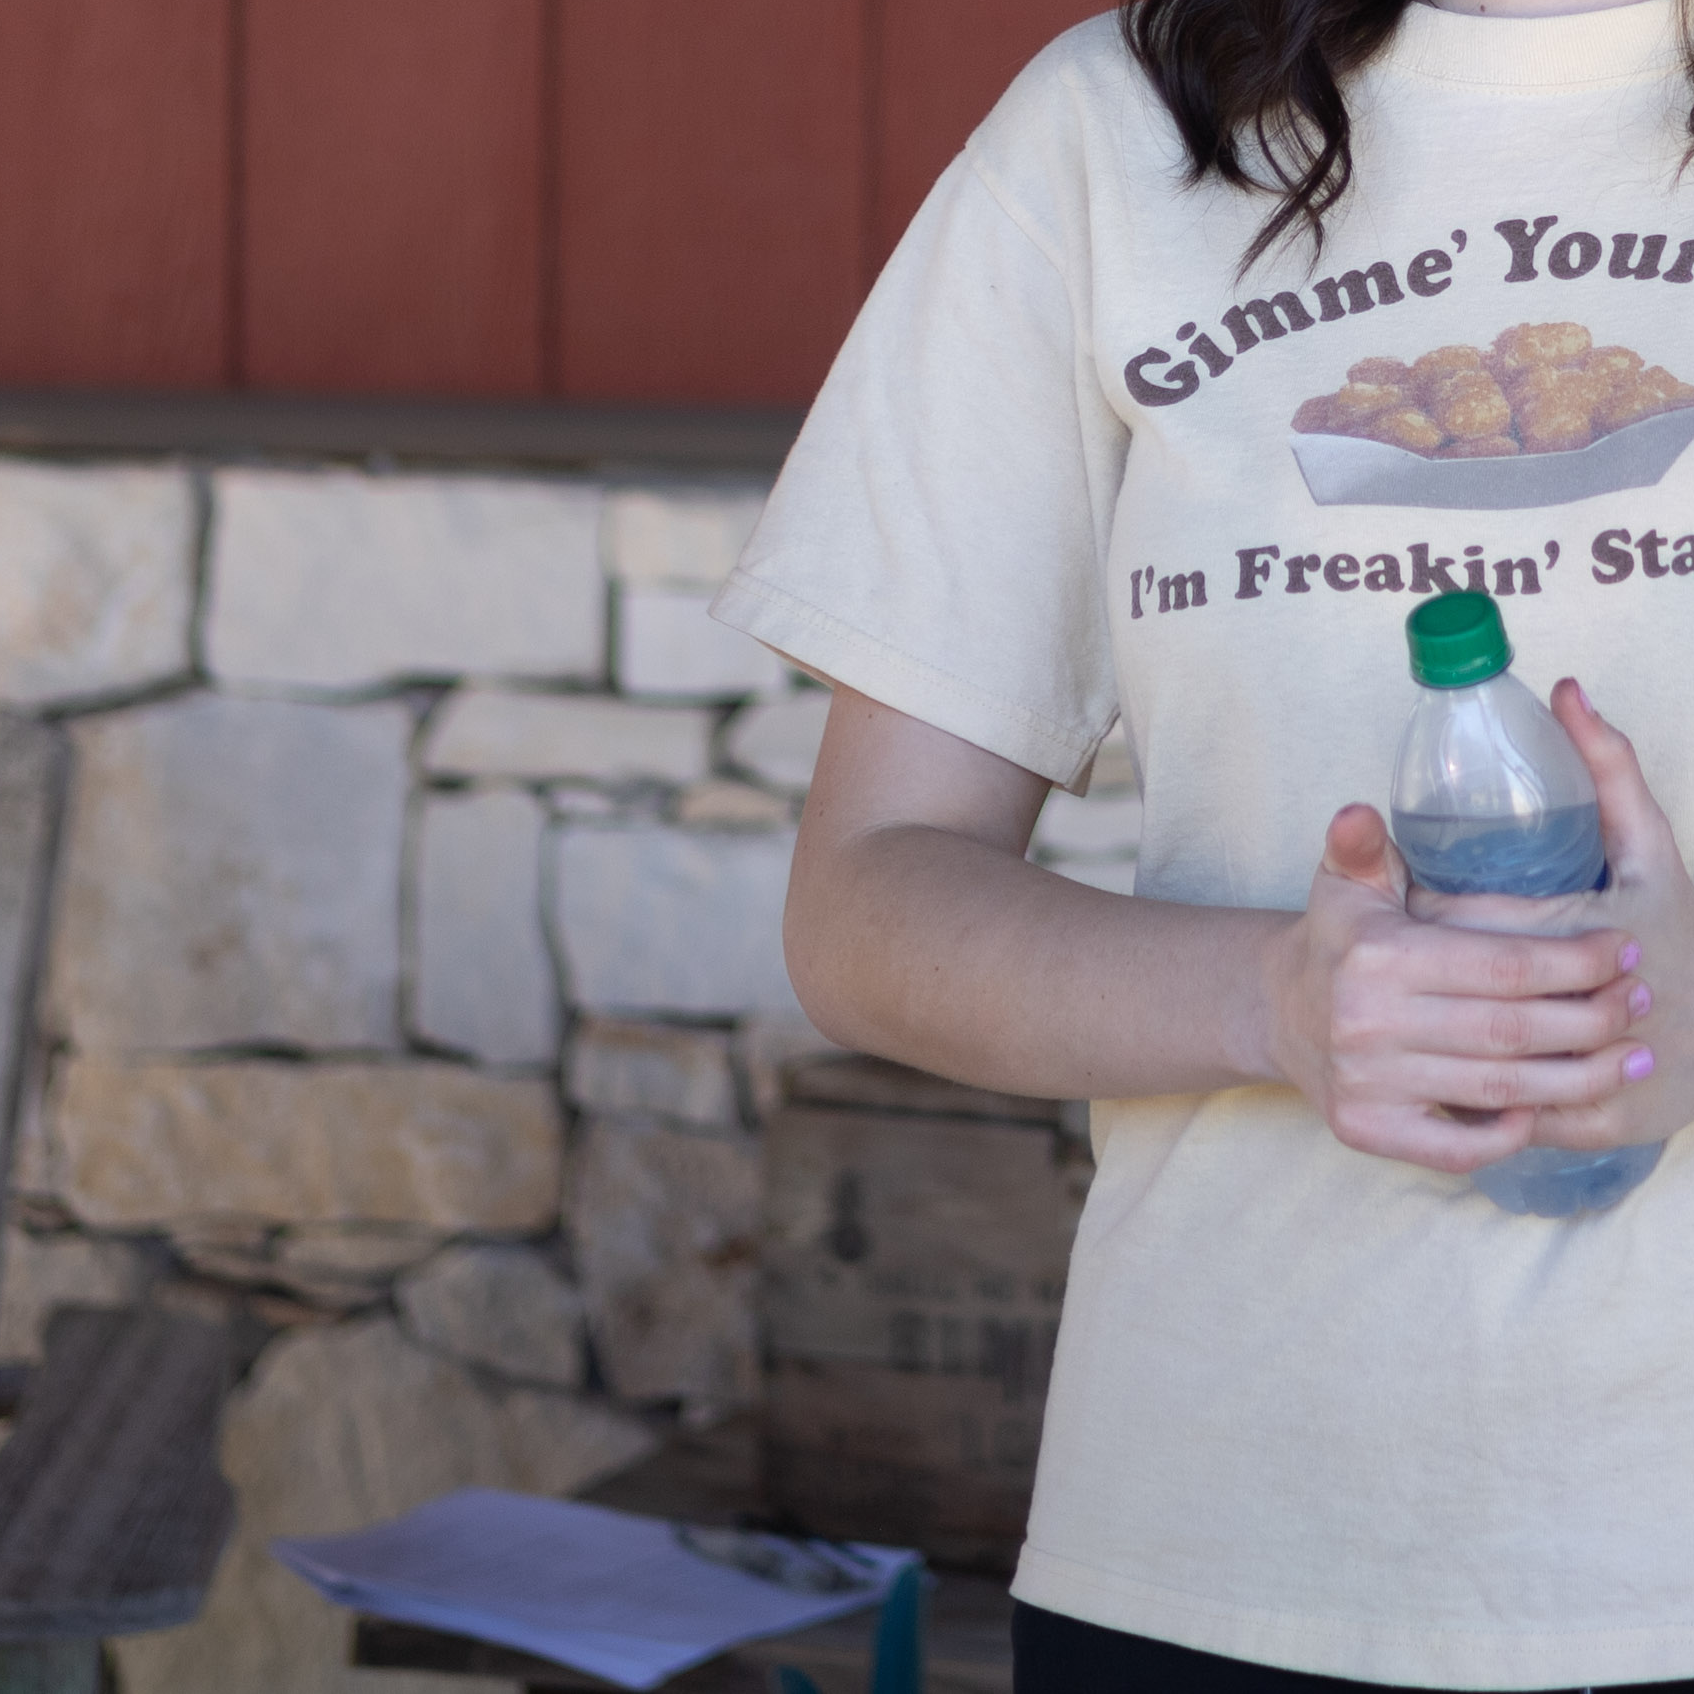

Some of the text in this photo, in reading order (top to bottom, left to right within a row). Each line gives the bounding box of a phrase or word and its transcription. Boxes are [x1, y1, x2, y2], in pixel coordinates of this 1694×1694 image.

[1123, 228, 1468, 407] Gimme'
[1130, 565, 1208, 620] I'm
[1234, 540, 1562, 597] Freakin'
